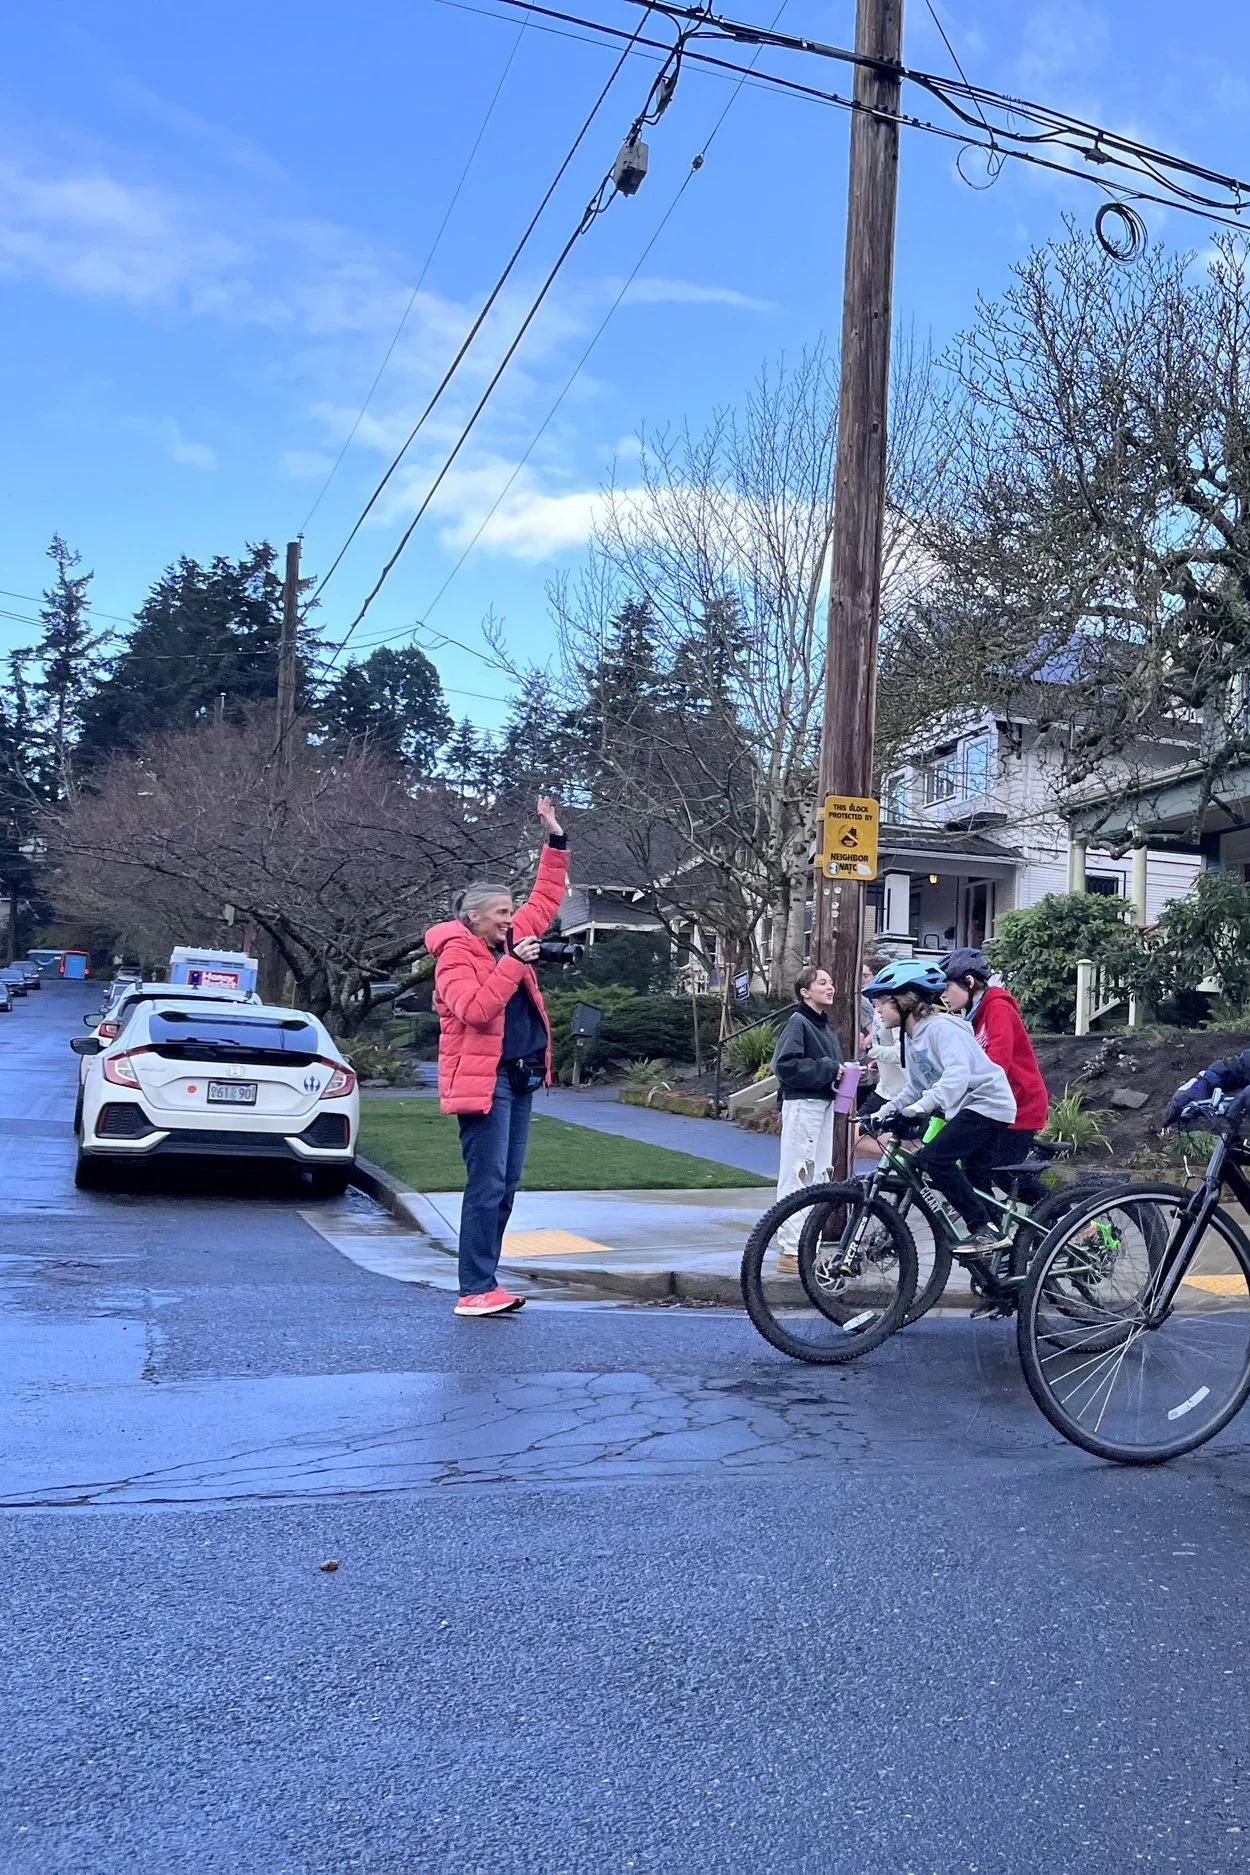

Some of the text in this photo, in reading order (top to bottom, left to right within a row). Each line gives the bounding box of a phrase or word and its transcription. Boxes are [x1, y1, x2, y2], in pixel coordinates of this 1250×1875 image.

[849, 804, 868, 813] BLOCK
[828, 812, 862, 820] PROTECTED
[831, 853, 869, 862] NEIGHBOR
[920, 1187, 940, 1213] CLEARY
[843, 1241, 858, 1266] XCR
